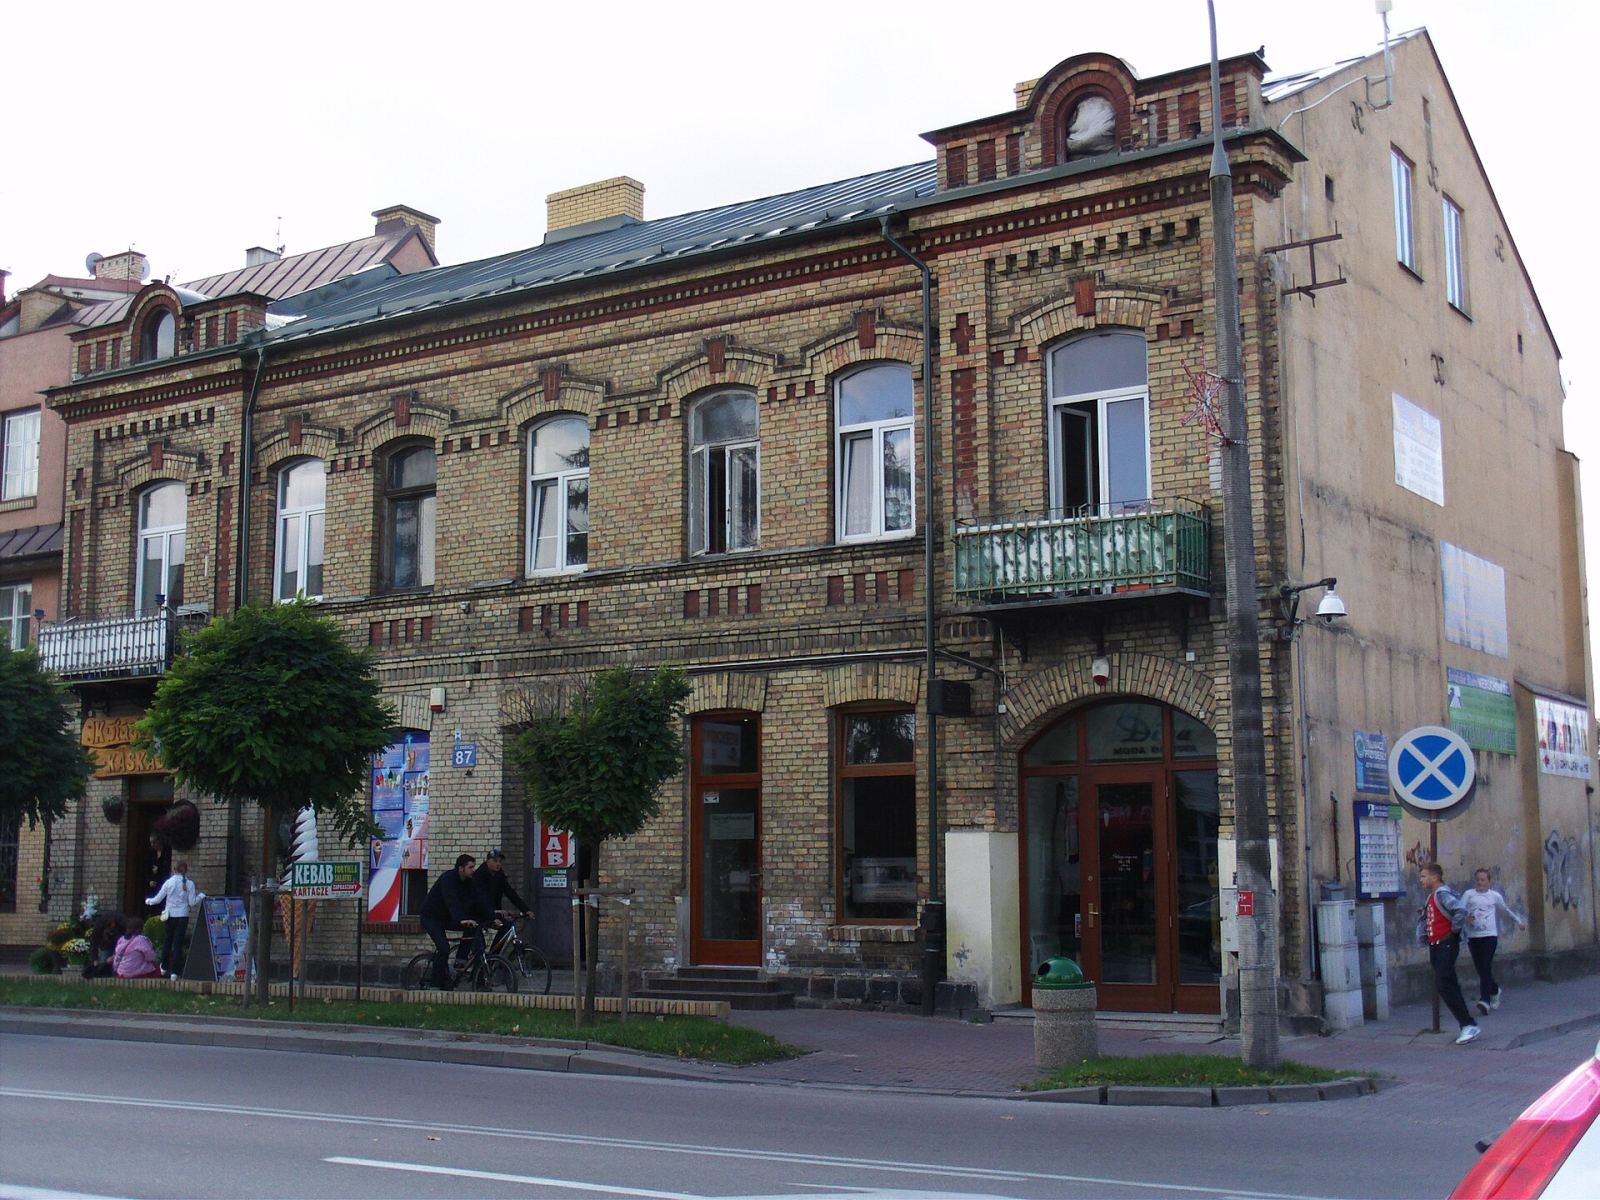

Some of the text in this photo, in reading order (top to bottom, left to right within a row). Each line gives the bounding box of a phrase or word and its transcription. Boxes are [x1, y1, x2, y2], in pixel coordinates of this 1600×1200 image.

[455, 750, 472, 765] 87
[295, 864, 334, 884] KEBAB
[292, 886, 329, 897] KARTACZE
